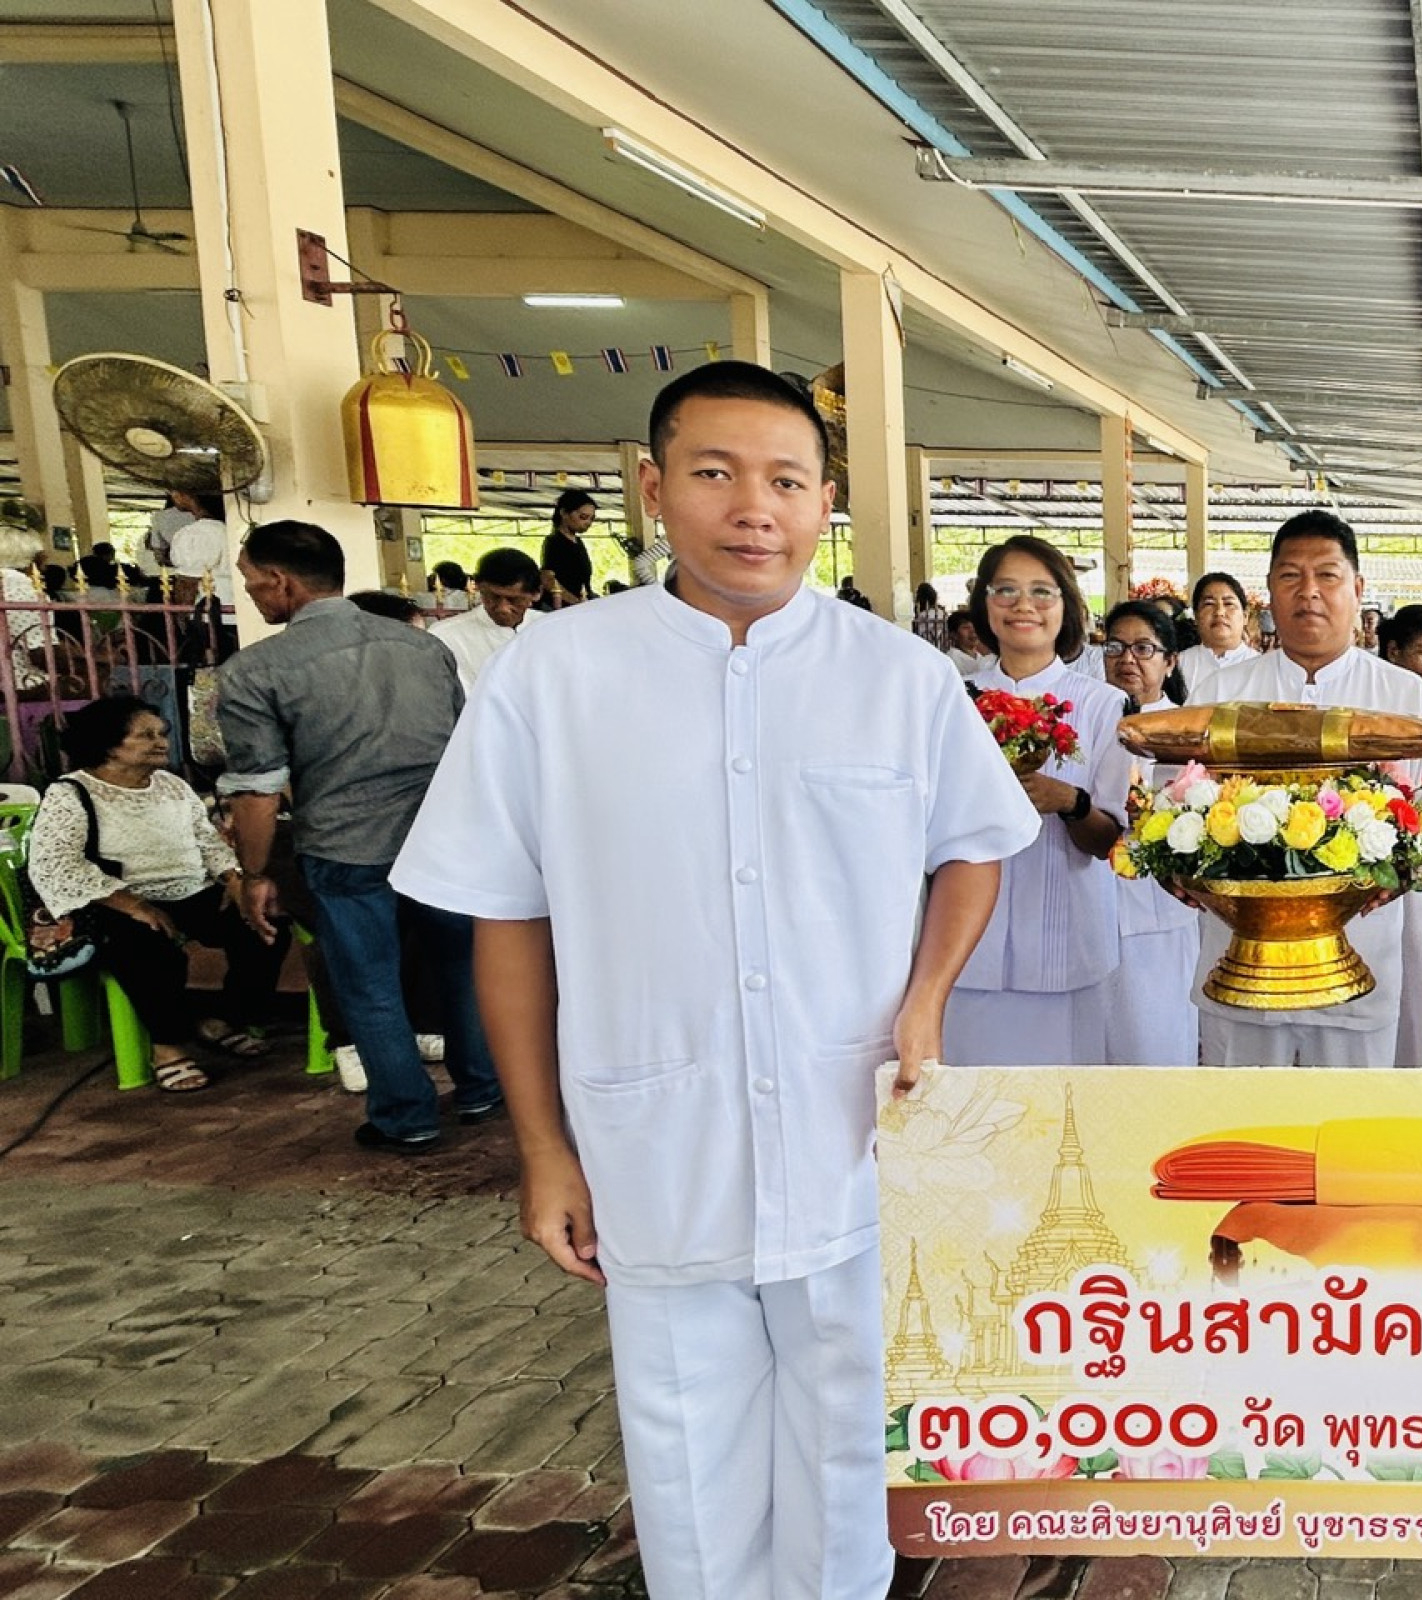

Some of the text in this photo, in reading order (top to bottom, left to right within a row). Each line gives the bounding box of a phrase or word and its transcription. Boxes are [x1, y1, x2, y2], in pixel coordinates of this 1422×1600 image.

[919, 1402, 1218, 1458] ๓๐,๐๐๐
[1242, 1396, 1305, 1448] วัด
[930, 1505, 995, 1538] โดย
[1012, 1503, 1282, 1547] คณะศิษยานุศิษย์
